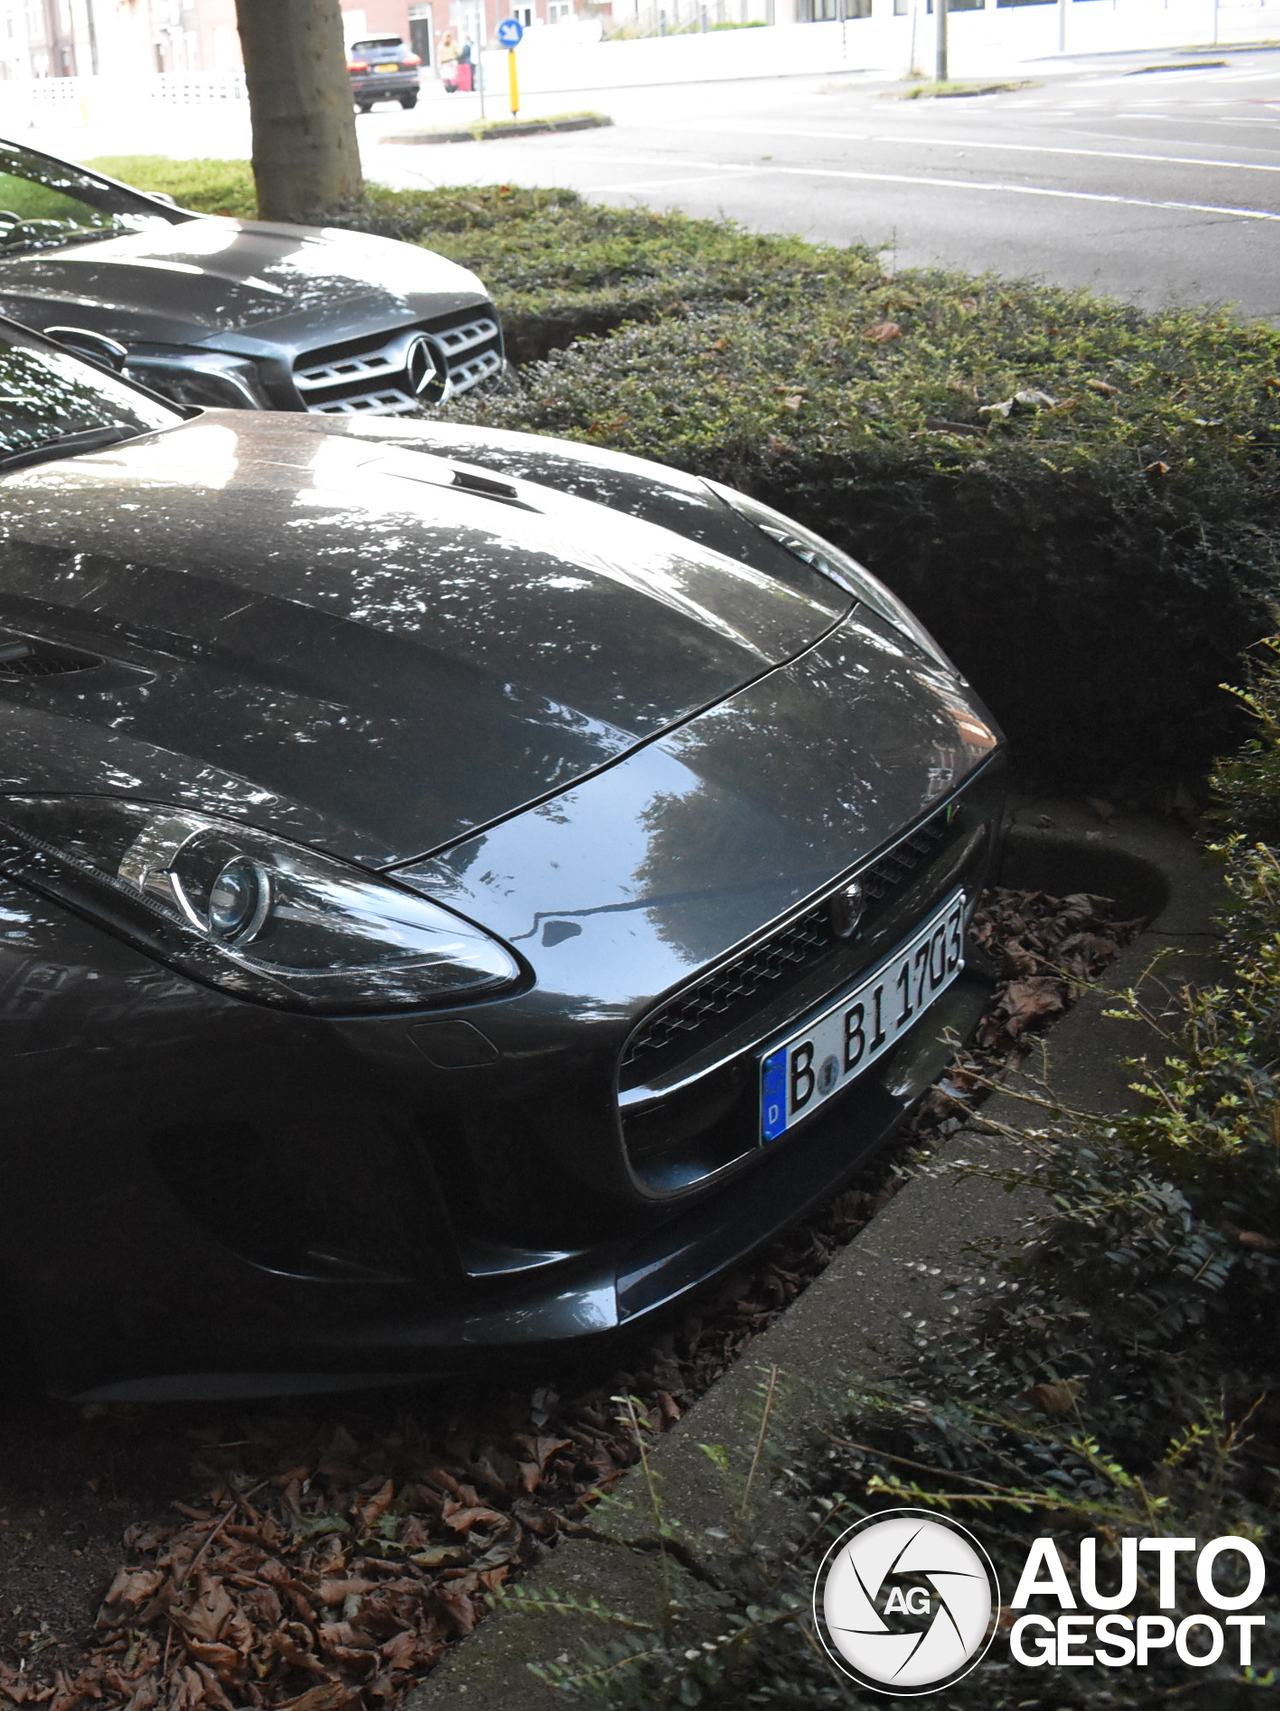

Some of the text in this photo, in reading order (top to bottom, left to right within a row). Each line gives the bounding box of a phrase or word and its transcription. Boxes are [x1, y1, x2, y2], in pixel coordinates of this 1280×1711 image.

[789, 906, 962, 1117] B BI 1703
[768, 1104, 779, 1125] D
